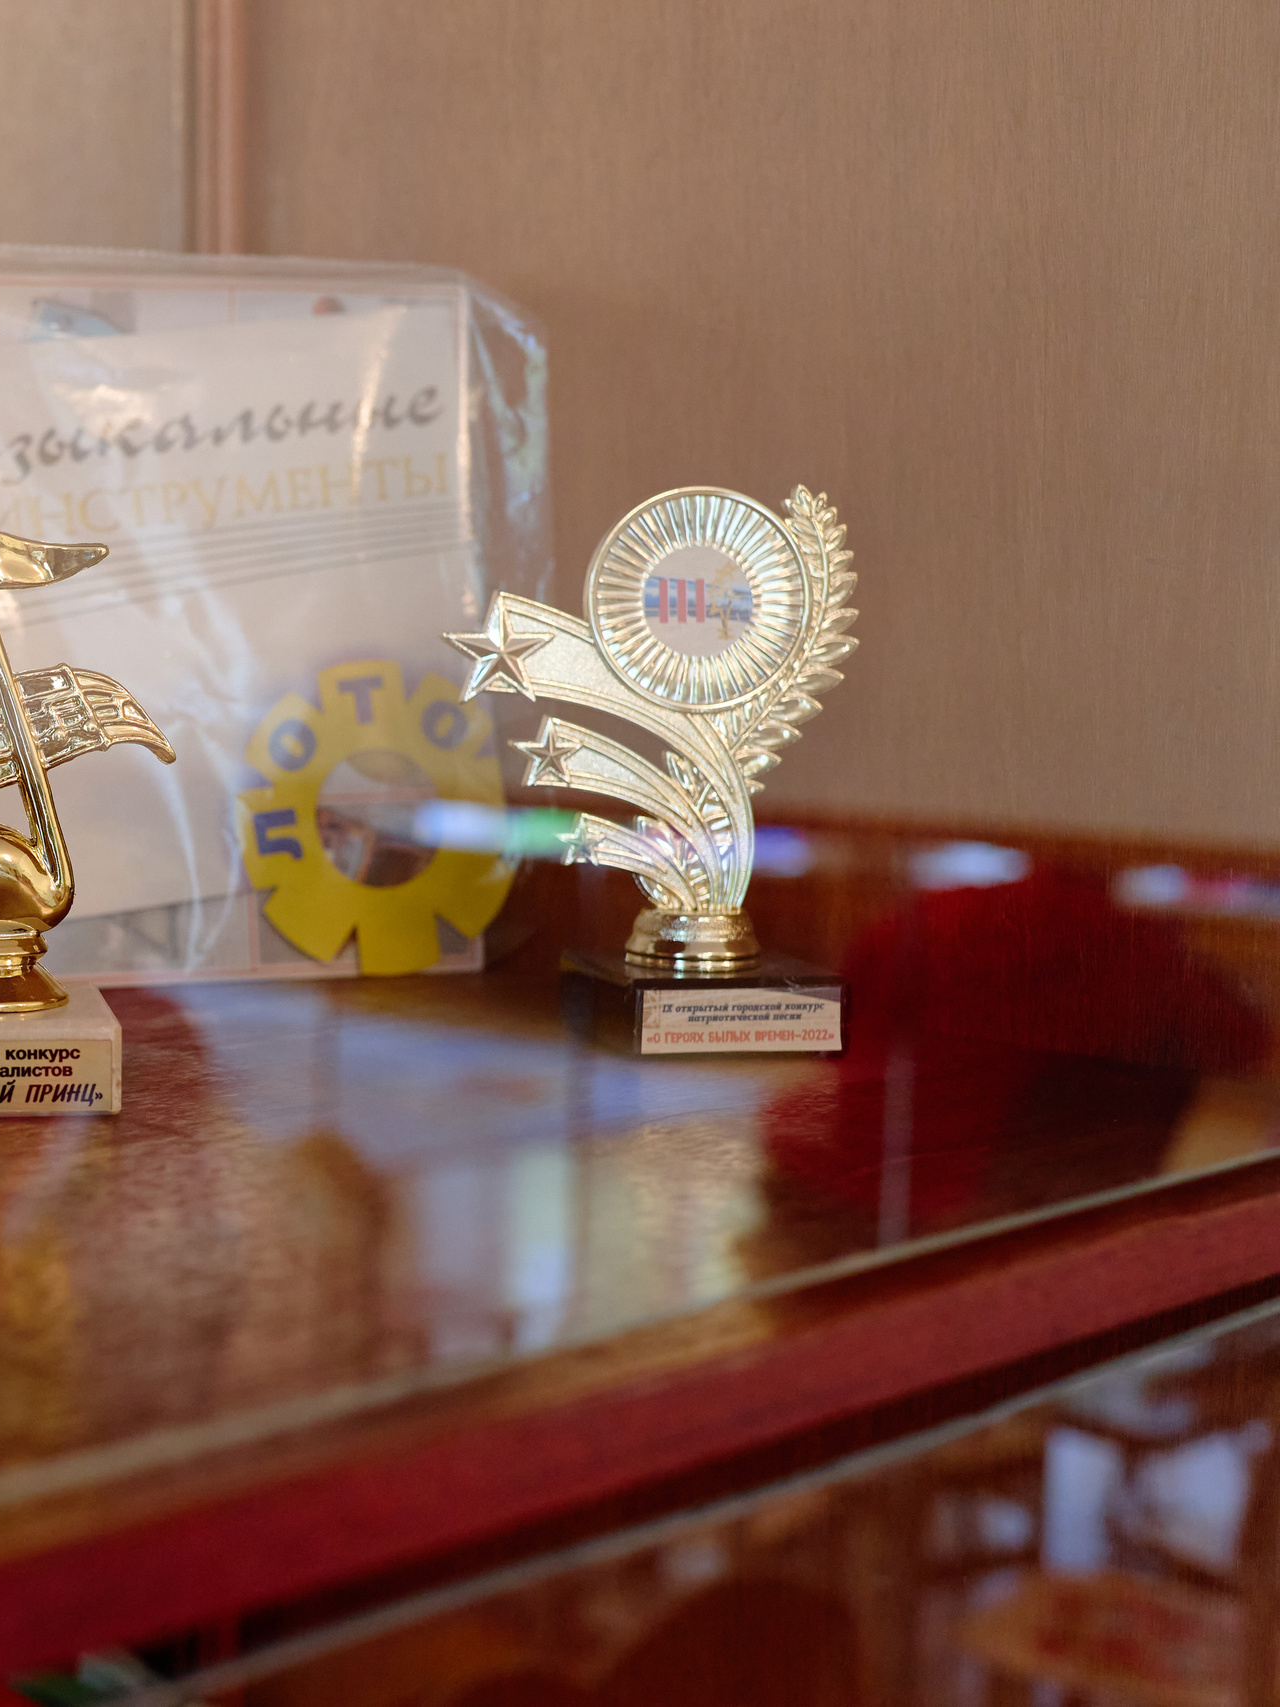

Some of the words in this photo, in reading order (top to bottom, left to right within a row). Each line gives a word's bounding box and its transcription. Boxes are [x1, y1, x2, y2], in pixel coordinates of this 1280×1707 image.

[252, 674, 469, 861] ЛОТО
[675, 1002, 729, 1015] открытый
[731, 1002, 782, 1015] городской
[784, 1001, 825, 1013] конкурс
[687, 1012, 770, 1025] патриотической
[773, 1012, 802, 1021] песни
[664, 1031, 704, 1044] ГЕРОЯХ
[708, 1030, 751, 1043] БЫЛЫХ
[5, 1047, 81, 1064] конкурс
[25, 1082, 104, 1107] ПРИНЦ»
